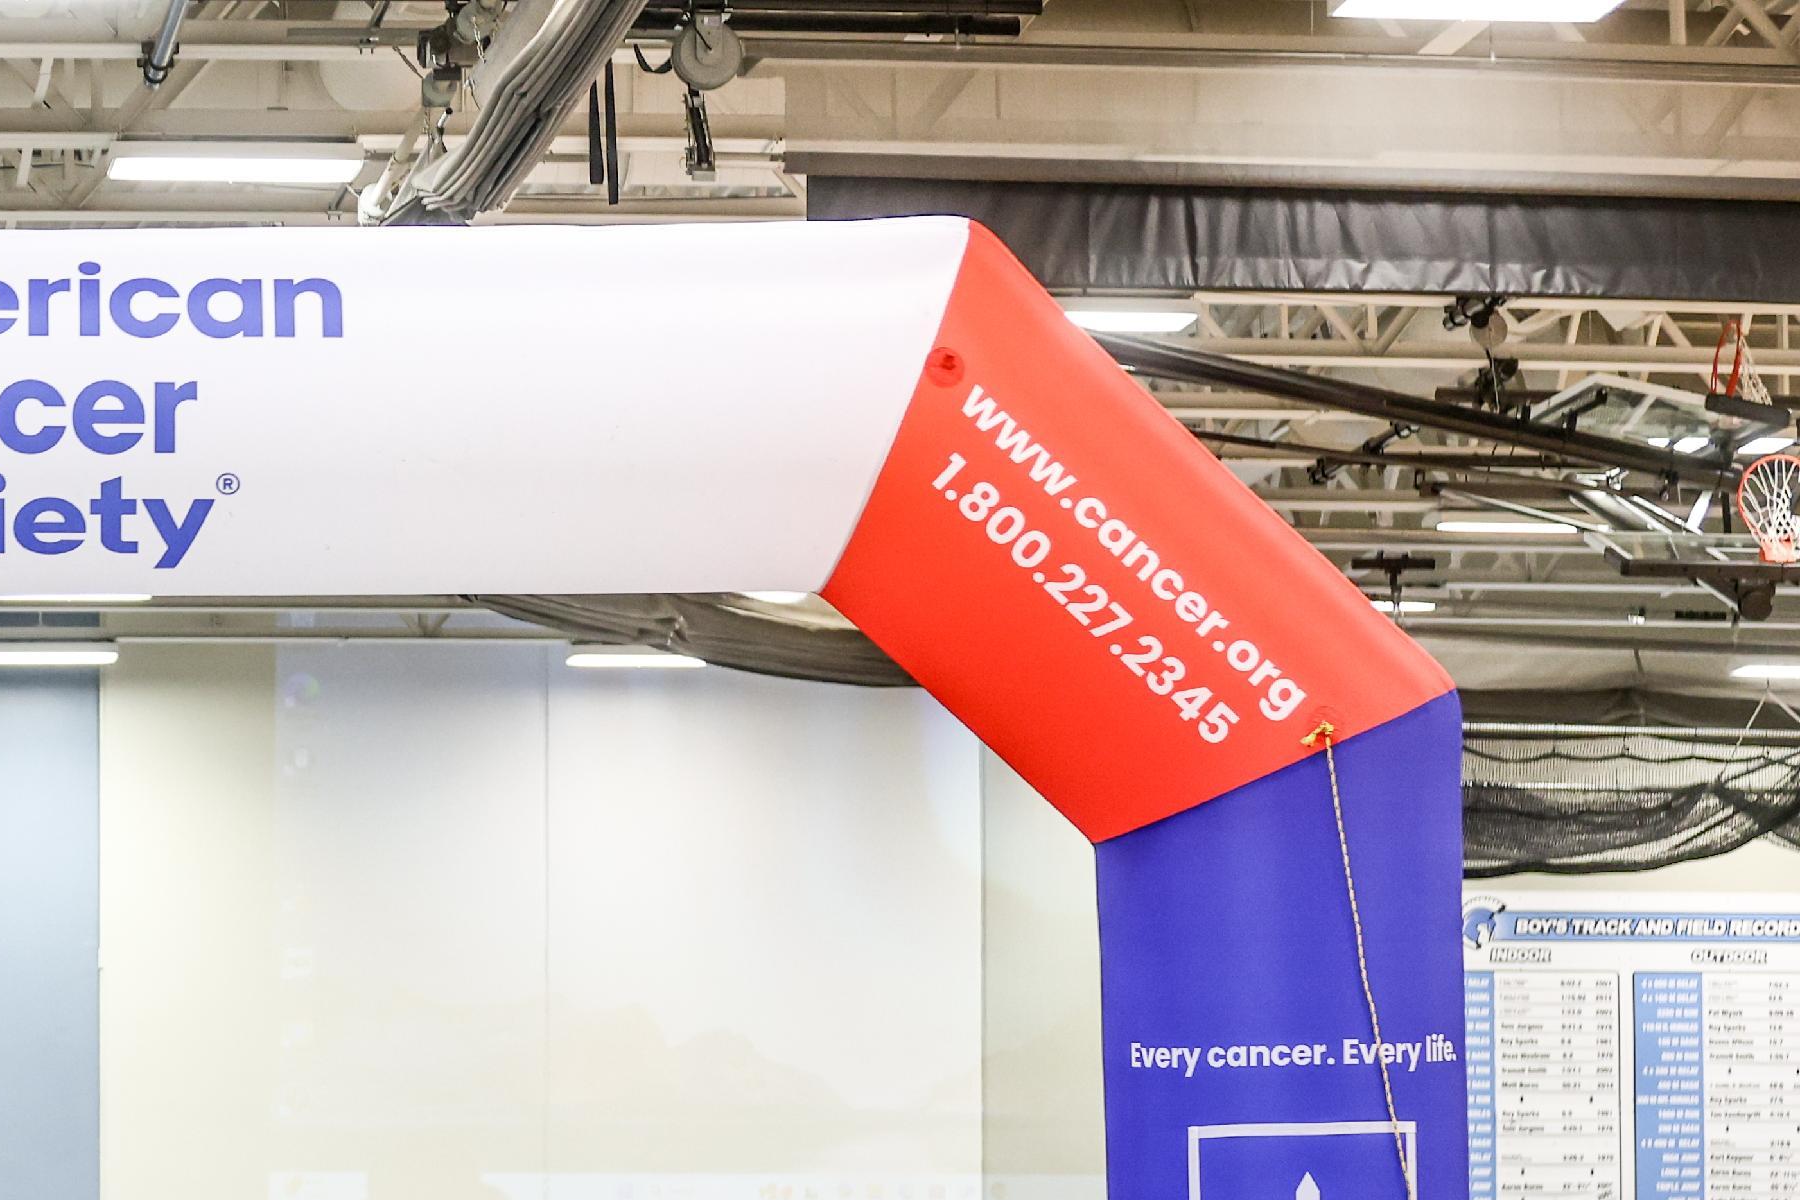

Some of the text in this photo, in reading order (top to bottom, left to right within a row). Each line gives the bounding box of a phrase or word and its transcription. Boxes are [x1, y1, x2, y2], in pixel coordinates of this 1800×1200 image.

[961, 385, 1307, 721] www.cancer.org
[931, 452, 1239, 744] 1.800.227.2345
[1571, 917, 1634, 936] TRACK
[1632, 918, 1674, 936] AND
[1675, 918, 1727, 936] FIELD
[1489, 947, 1552, 963] INDOOR
[1690, 948, 1768, 964] OUTDOOR
[1130, 1033, 1457, 1078] Every cancer. Every life.
